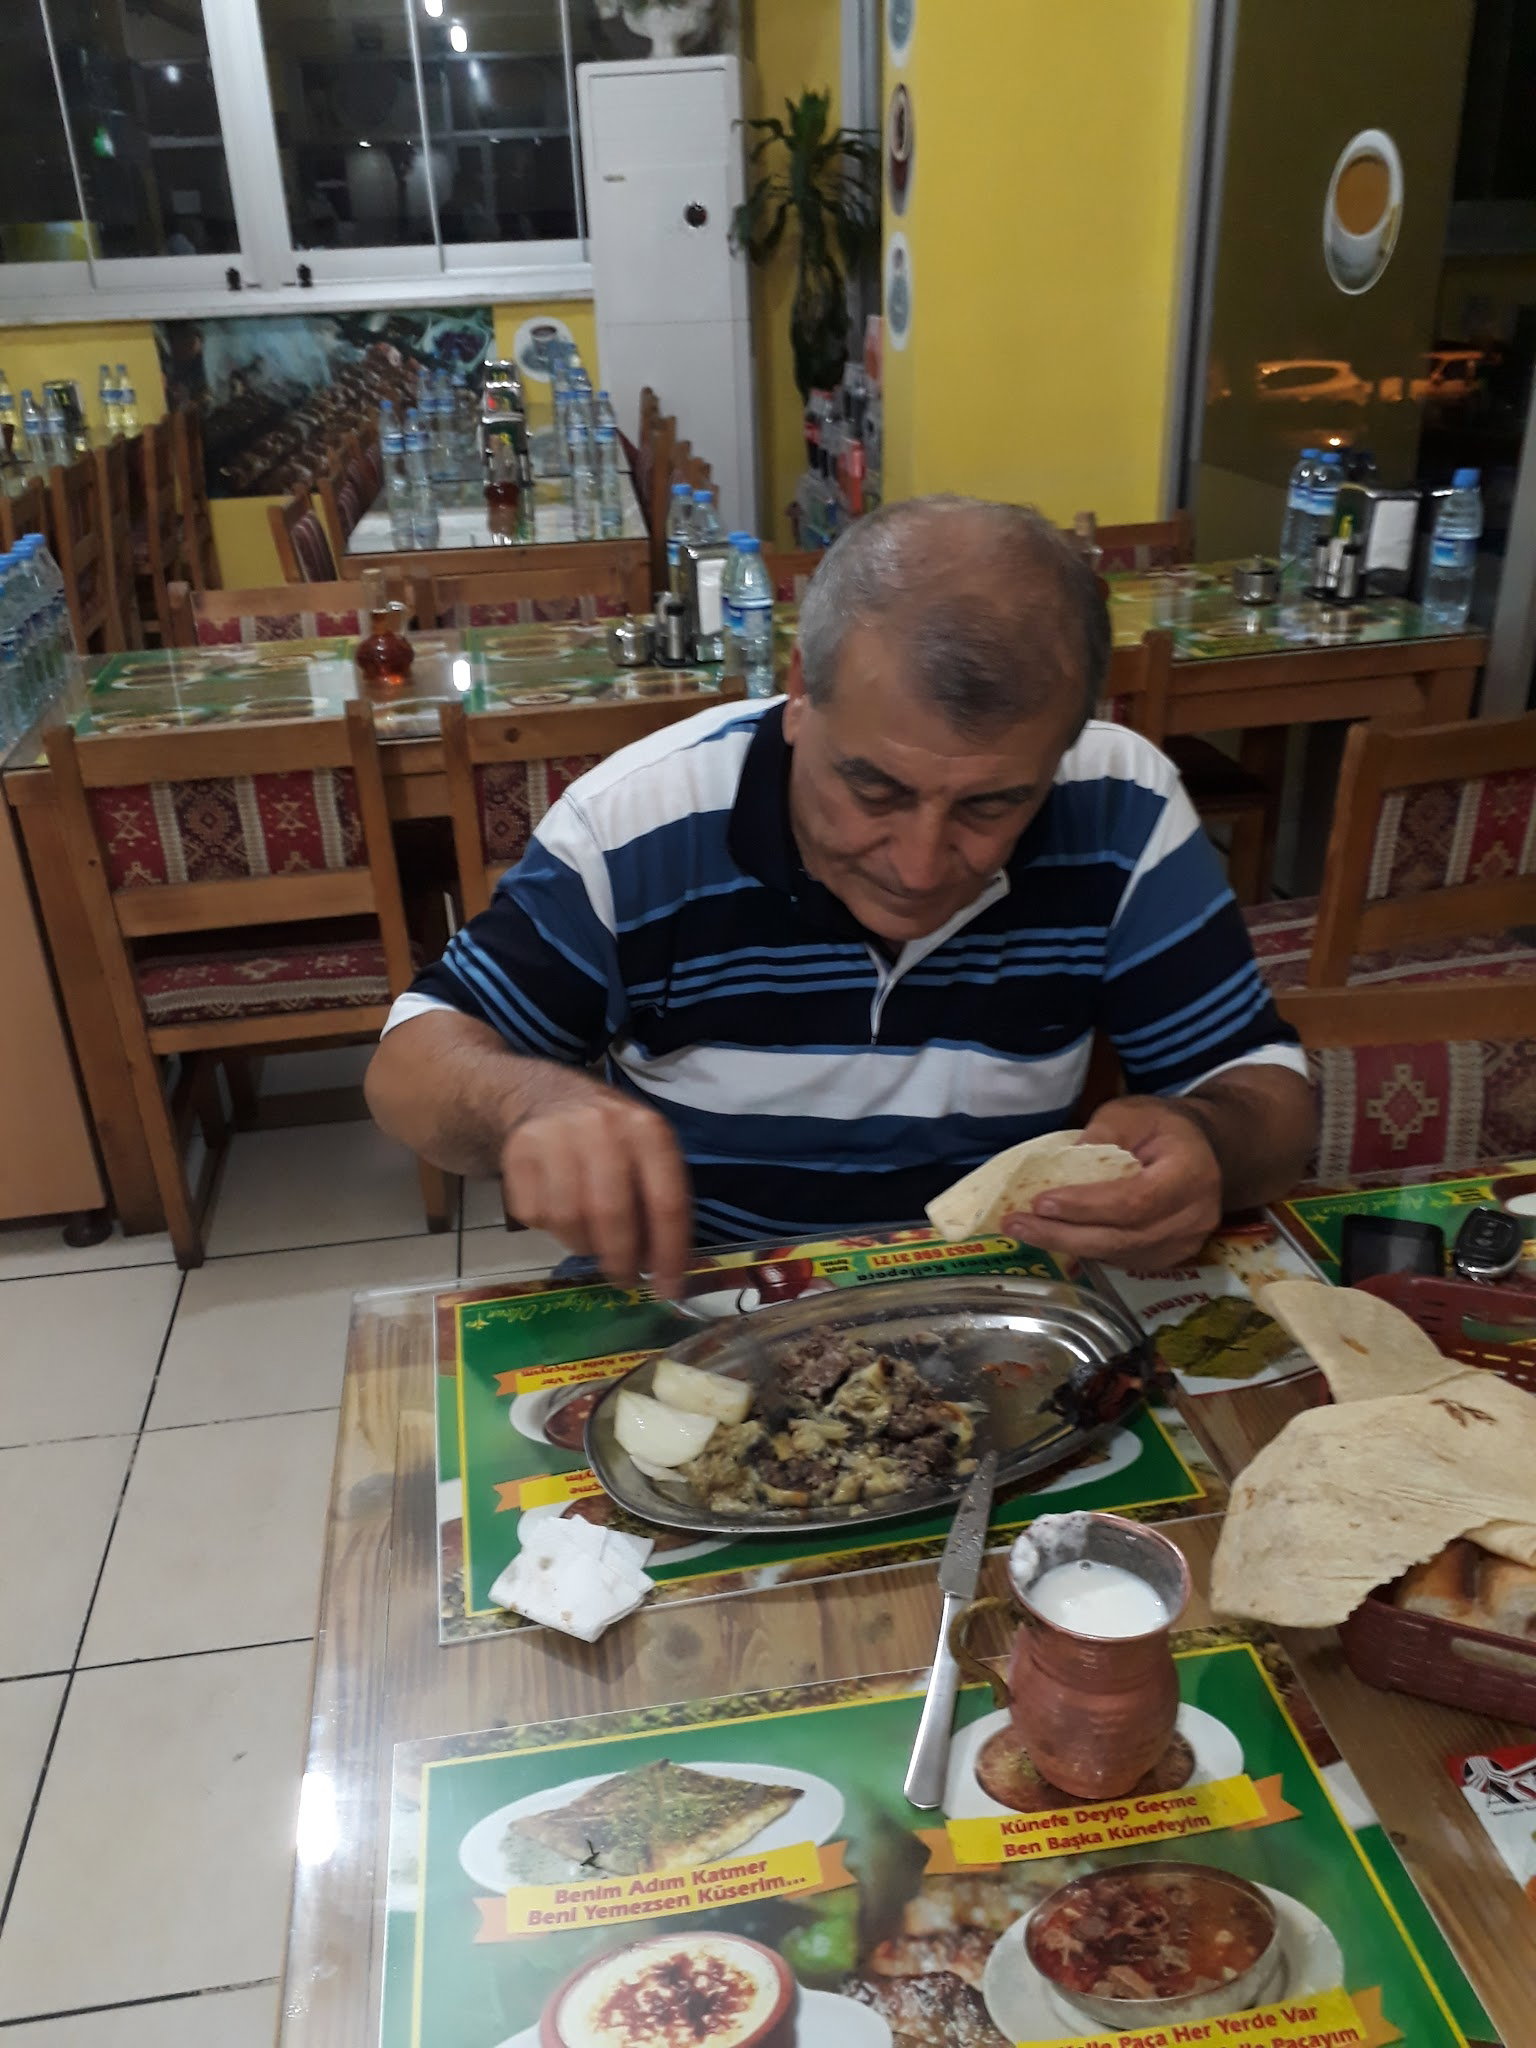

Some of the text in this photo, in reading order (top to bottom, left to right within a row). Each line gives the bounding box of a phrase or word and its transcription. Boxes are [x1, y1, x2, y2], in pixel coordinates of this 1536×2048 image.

[1000, 1795, 1198, 1836] Künefe Deyip Geçme
[1003, 1814, 1211, 1857] Ben Başka Künefeyim
[554, 1860, 768, 1904] Benim Adım Katmer
[527, 1907, 577, 1926] Beni
[584, 1894, 690, 1920] Yemezsen
[1172, 2025, 1211, 2044] Her
[1215, 2012, 1278, 2034] Yerde
[1280, 2006, 1317, 2024] Var
